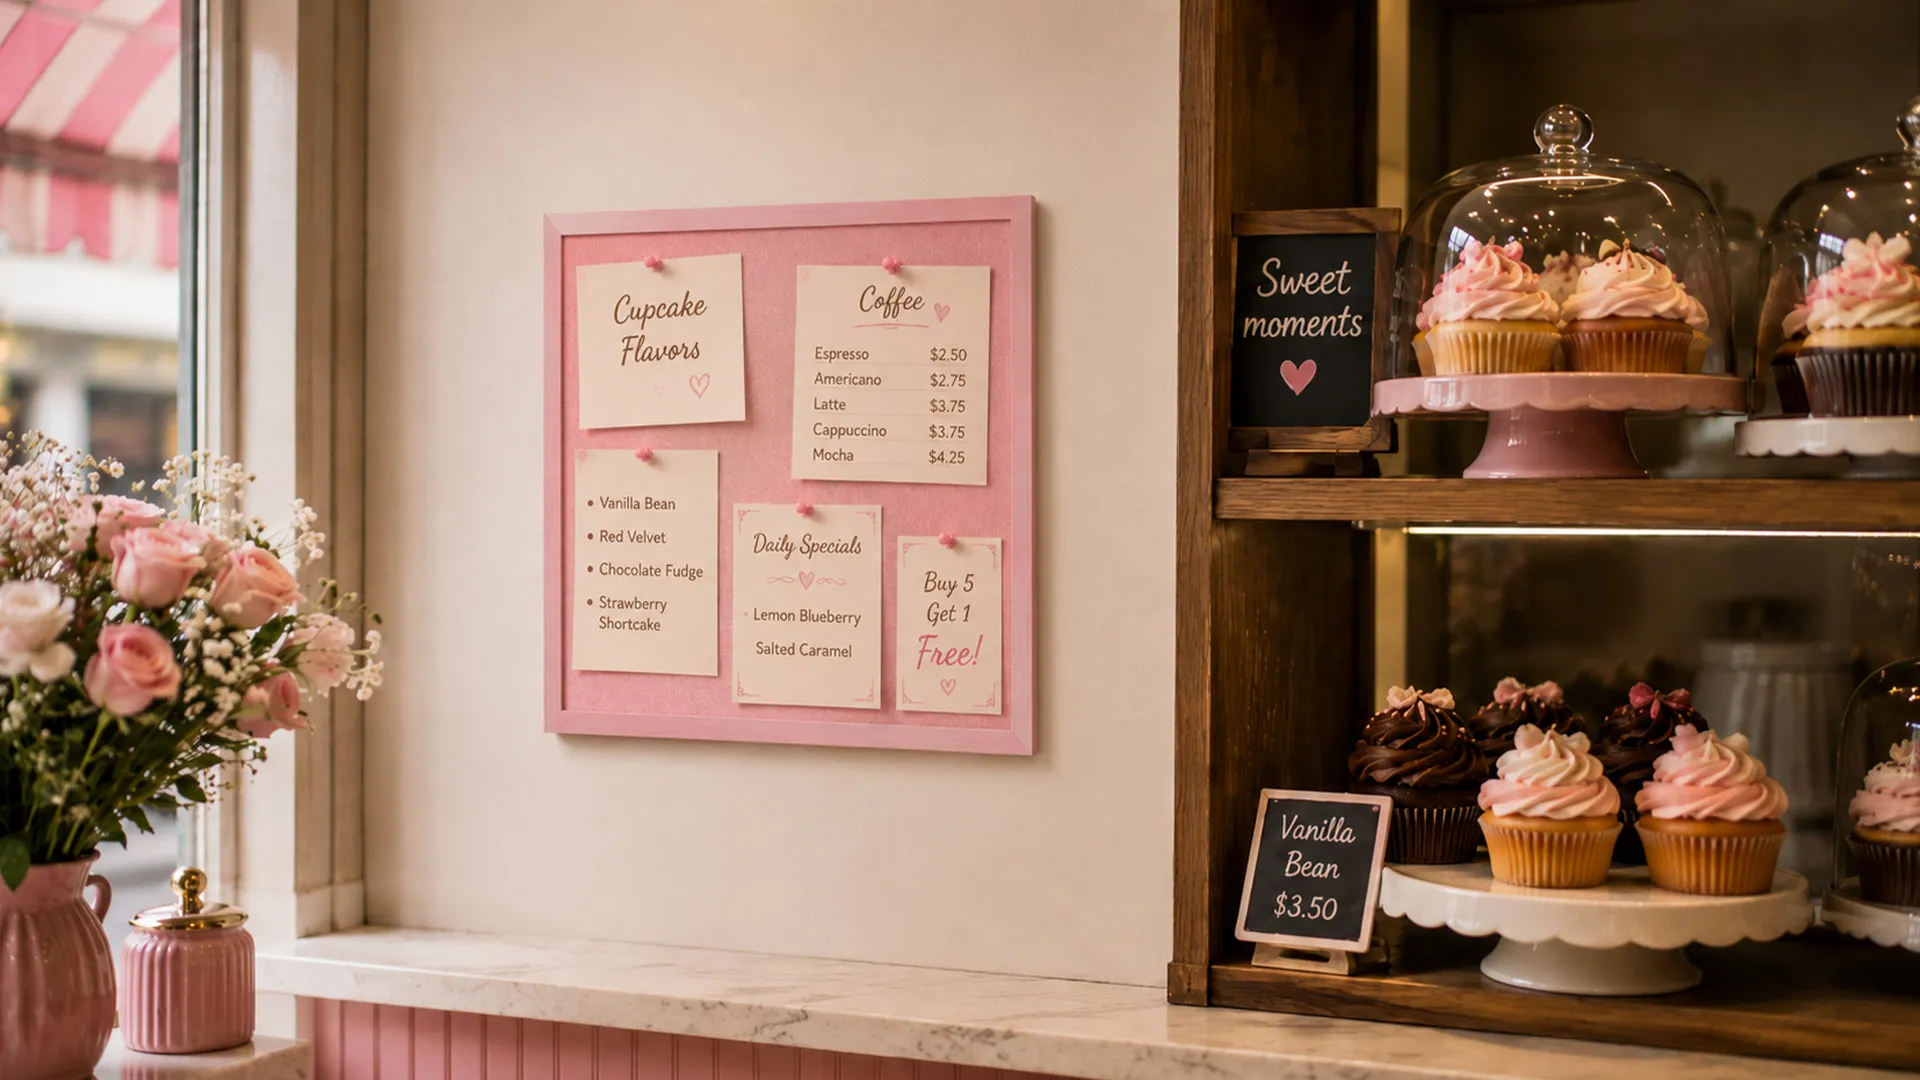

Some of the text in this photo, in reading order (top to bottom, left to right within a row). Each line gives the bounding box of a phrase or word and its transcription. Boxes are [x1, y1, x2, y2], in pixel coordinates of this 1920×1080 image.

[1258, 258, 1351, 297] Sweet
[614, 291, 707, 330] Cupcake
[860, 285, 925, 319] Coffee
[1244, 306, 1362, 337] moments
[622, 335, 700, 366] Flavors
[815, 347, 967, 363] Espresso $2.50
[814, 372, 966, 387] Americano $2.75
[814, 397, 965, 413] Latte $3.75
[813, 423, 965, 439] Cappuccino $3.75
[813, 448, 965, 464] Mocha $4.25
[600, 496, 675, 510] Vanilla Bean
[600, 530, 666, 543] Red Velvet
[754, 533, 861, 560] Daily Specials
[600, 562, 703, 581] Chocolate Fudge
[924, 571, 974, 596] Buy 5
[600, 596, 667, 614] Strawberry
[927, 602, 972, 627] Get 1
[599, 616, 660, 631] Shortcake
[754, 608, 861, 627] Lemon Blueberry
[757, 641, 851, 657] Salted Caramel
[917, 634, 983, 669] Free!
[1282, 814, 1356, 843] Vanilla
[1285, 850, 1340, 878] Bean
[1274, 891, 1337, 920] $3.50
